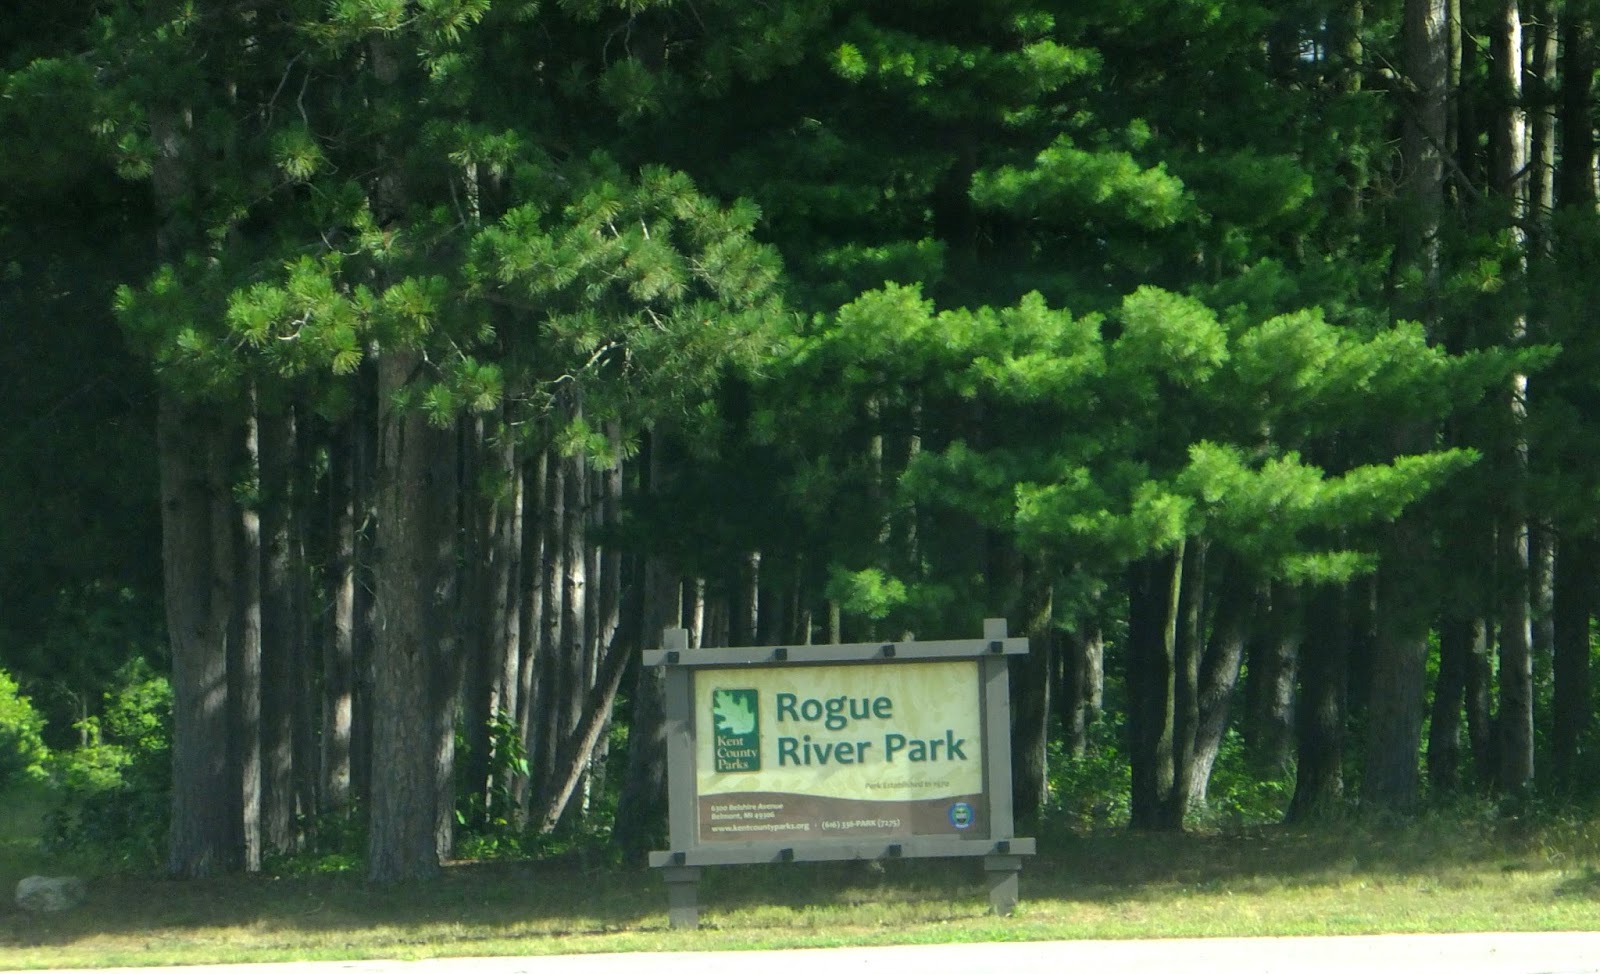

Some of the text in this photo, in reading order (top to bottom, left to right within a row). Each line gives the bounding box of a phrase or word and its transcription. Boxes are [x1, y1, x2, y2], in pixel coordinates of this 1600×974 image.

[776, 692, 894, 731] Rogue
[717, 735, 744, 746] Kent
[717, 747, 758, 758] County
[778, 729, 968, 766] River Park
[718, 758, 749, 770] Parks
[712, 823, 810, 832] www.kentcountyparks.org
